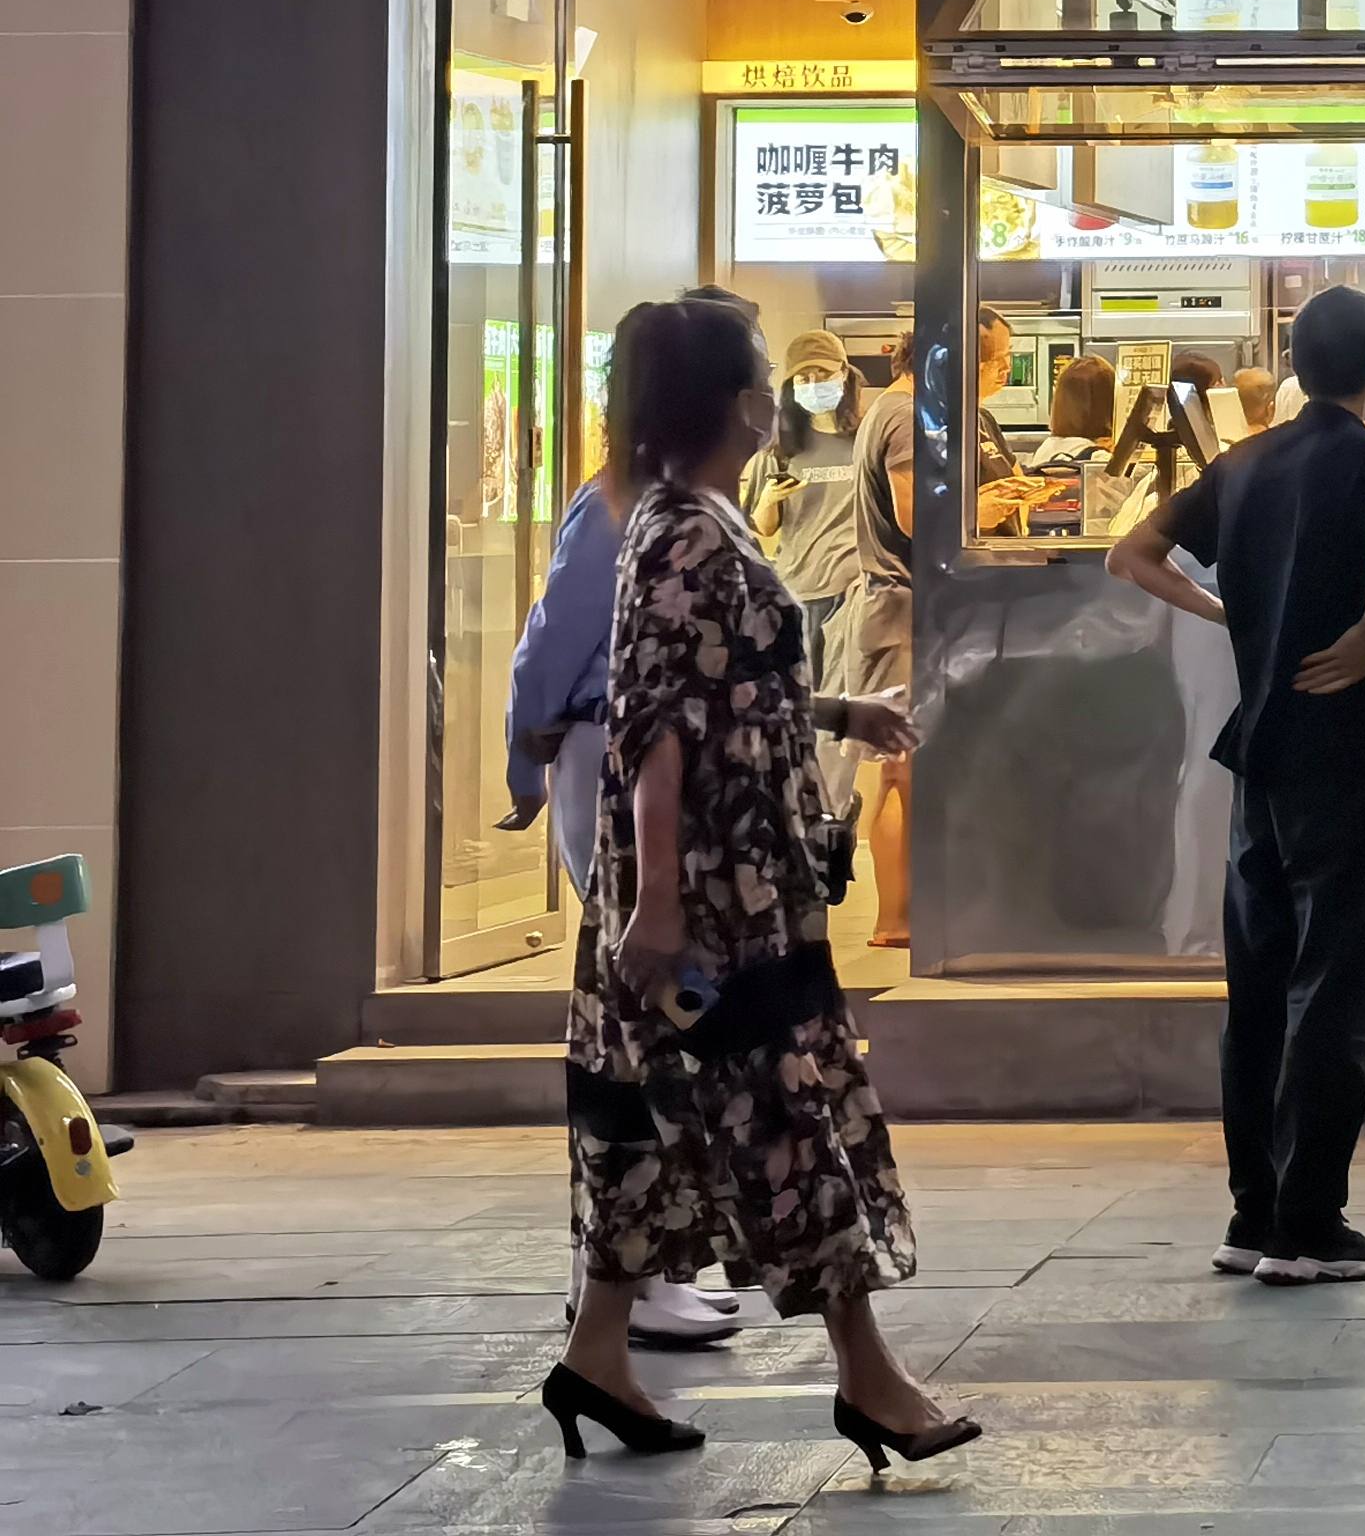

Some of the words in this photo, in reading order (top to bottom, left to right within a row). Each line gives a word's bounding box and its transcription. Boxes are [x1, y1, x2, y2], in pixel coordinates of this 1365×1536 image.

[742, 64, 852, 88] 烘焙饮品
[756, 142, 899, 176] 咖喱牛肉
[756, 182, 864, 215] 菠萝包
